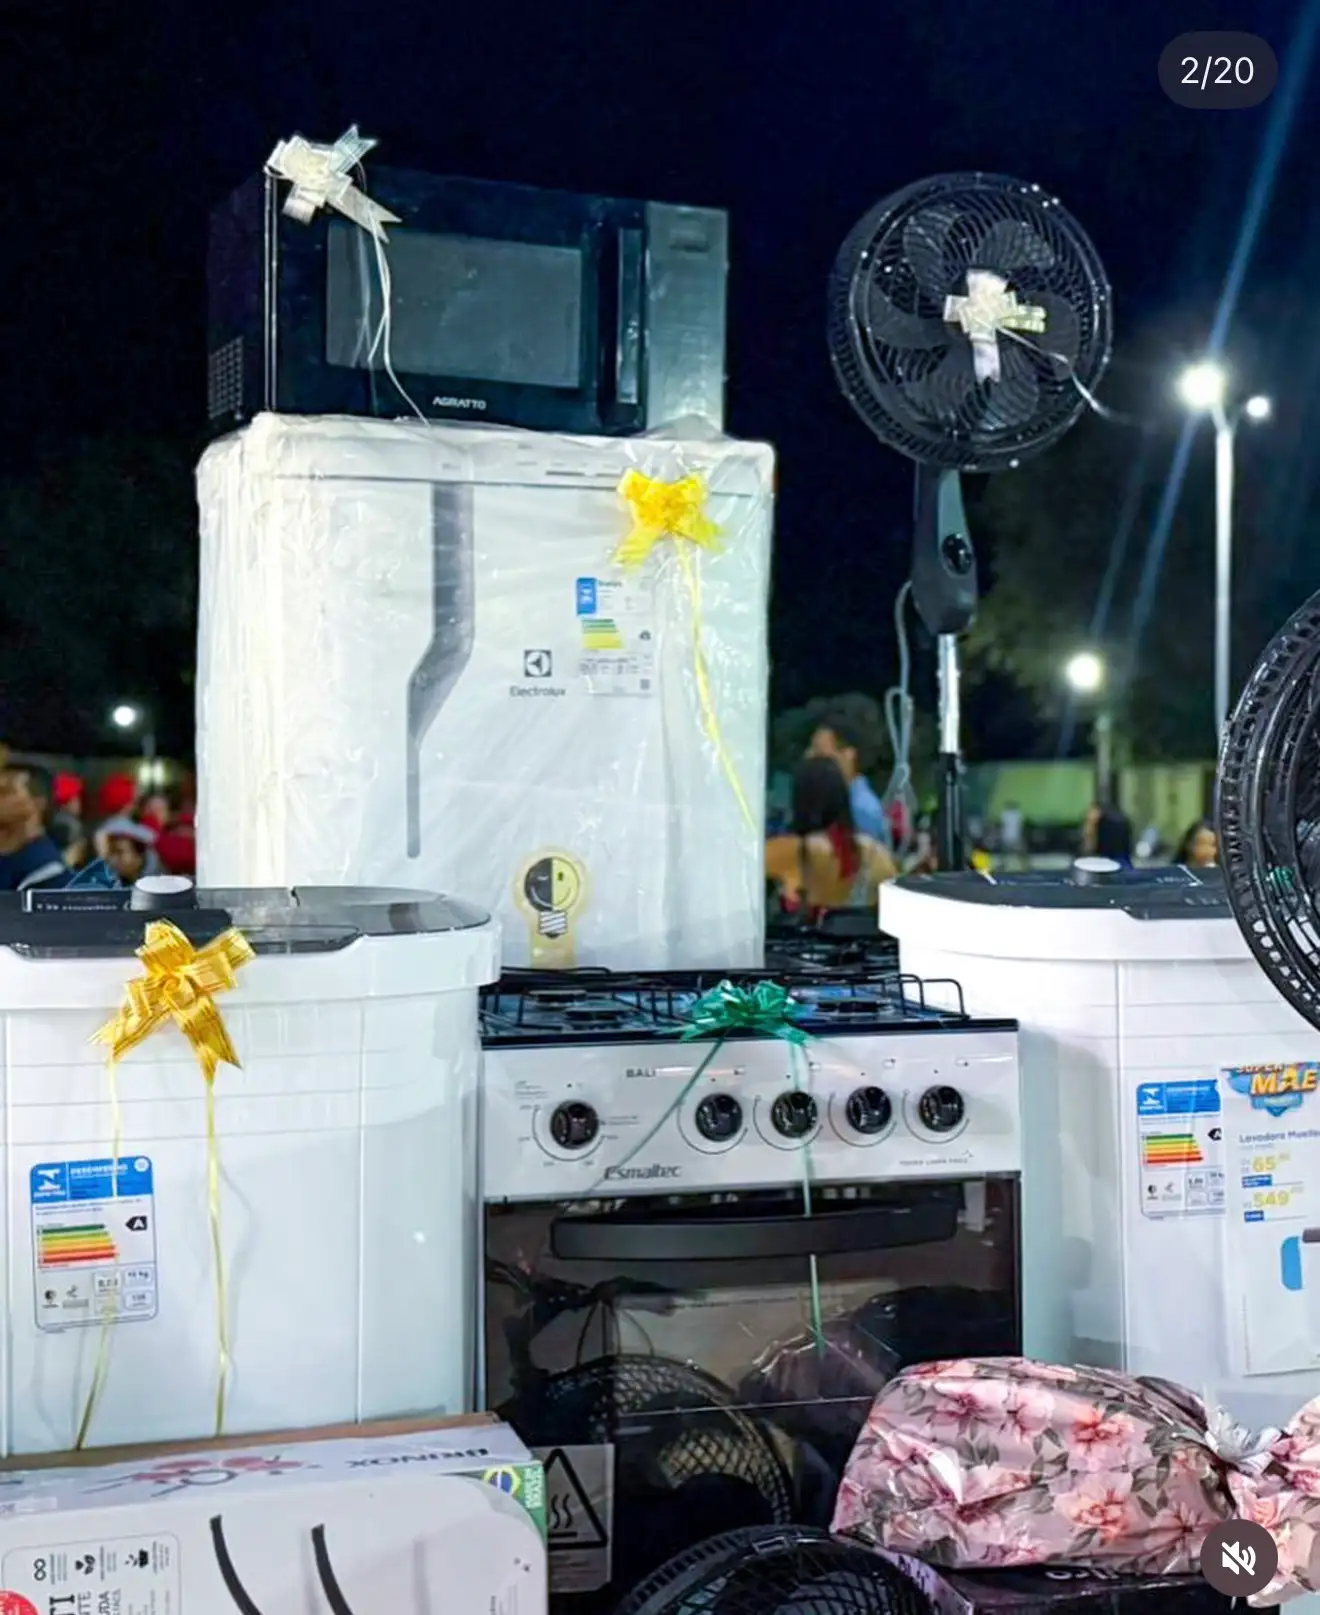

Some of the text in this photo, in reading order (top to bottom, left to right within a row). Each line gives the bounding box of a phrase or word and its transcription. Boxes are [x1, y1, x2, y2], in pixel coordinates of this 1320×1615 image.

[432, 396, 487, 410] AGRATTO
[509, 685, 566, 697] Electrolux
[626, 1069, 656, 1078] BALI
[604, 1163, 681, 1180] Esmaltec
[133, 1217, 145, 1230] A
